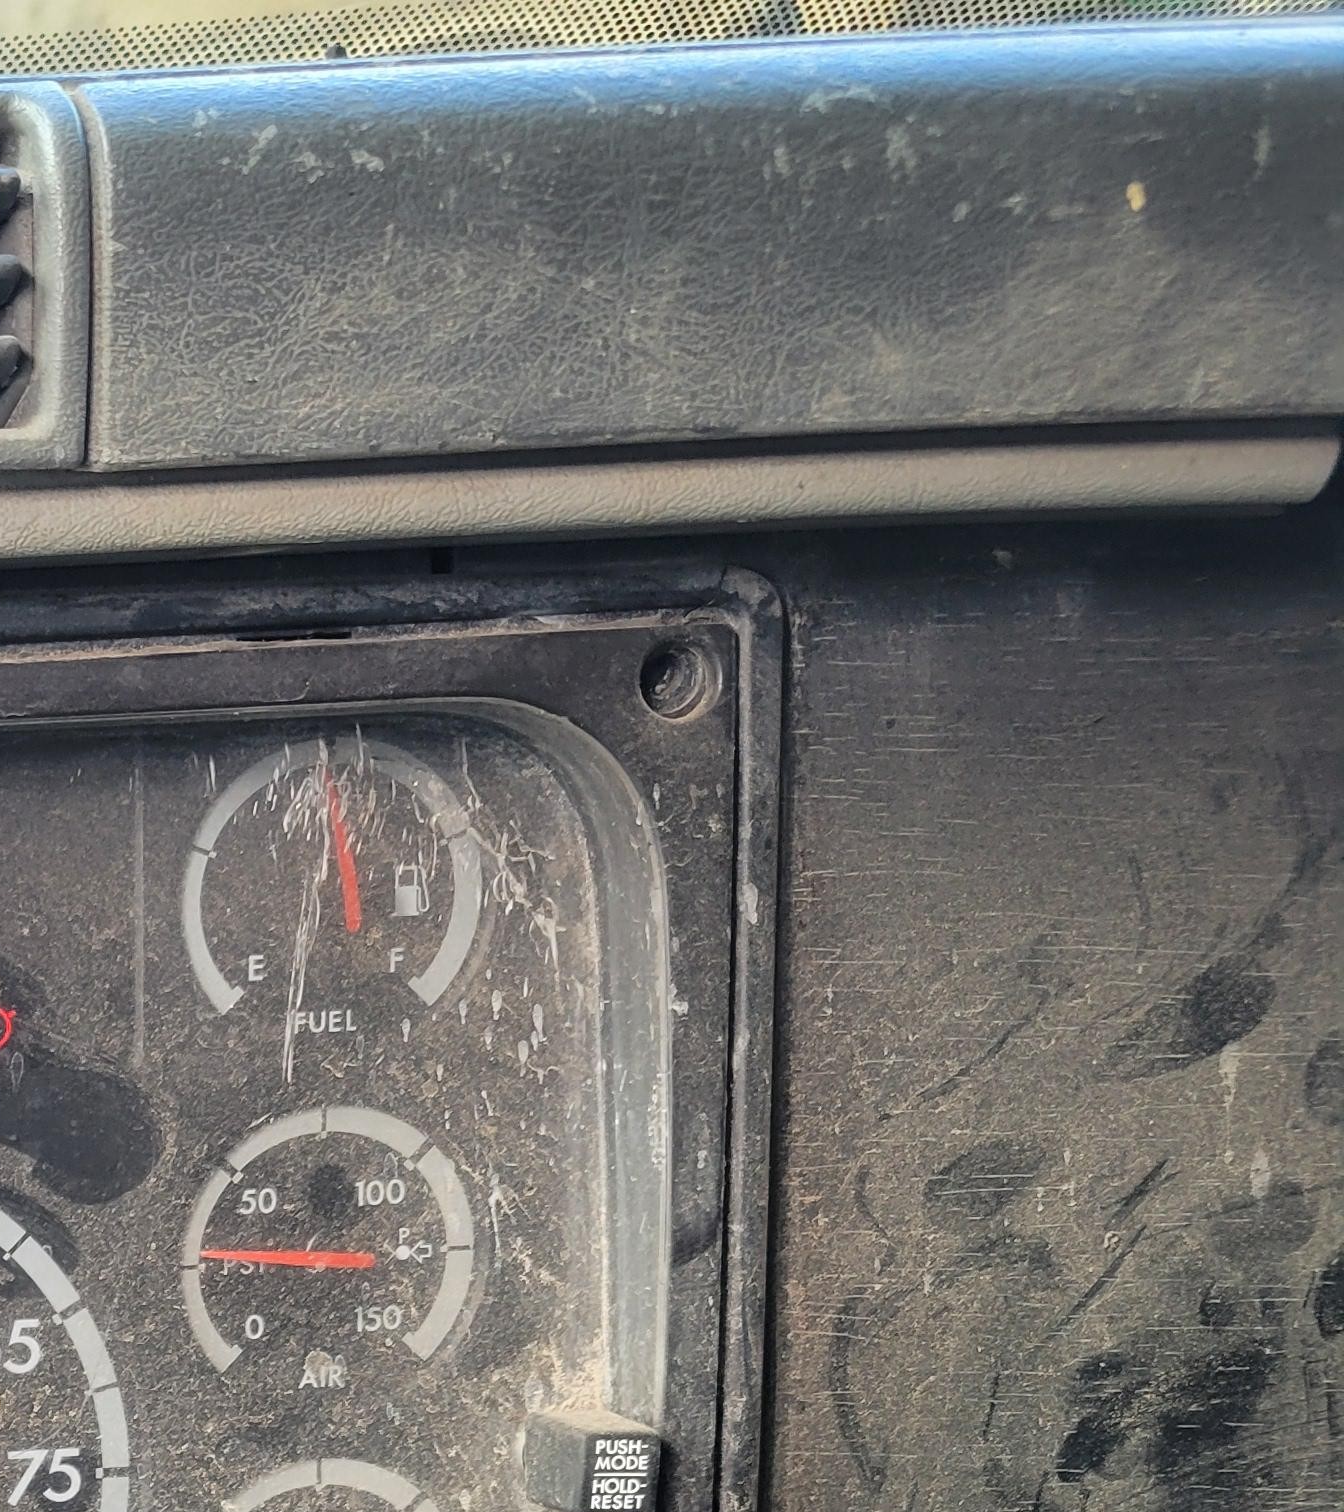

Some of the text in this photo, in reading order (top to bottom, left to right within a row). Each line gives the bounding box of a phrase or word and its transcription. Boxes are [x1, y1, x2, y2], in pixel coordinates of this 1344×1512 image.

[247, 954, 265, 982] E
[388, 948, 405, 973] F
[293, 1010, 358, 1034] FUEL
[238, 1187, 278, 1216] 50
[354, 1178, 406, 1207] 100
[244, 1314, 265, 1340] 0
[355, 1305, 403, 1333] 150
[298, 1365, 346, 1389] AIR
[595, 1439, 650, 1455] PUSH-
[594, 1455, 650, 1471] MODE
[6, 1446, 83, 1507] 75
[591, 1478, 648, 1494] HOLD-
[590, 1494, 646, 1510] RESET
